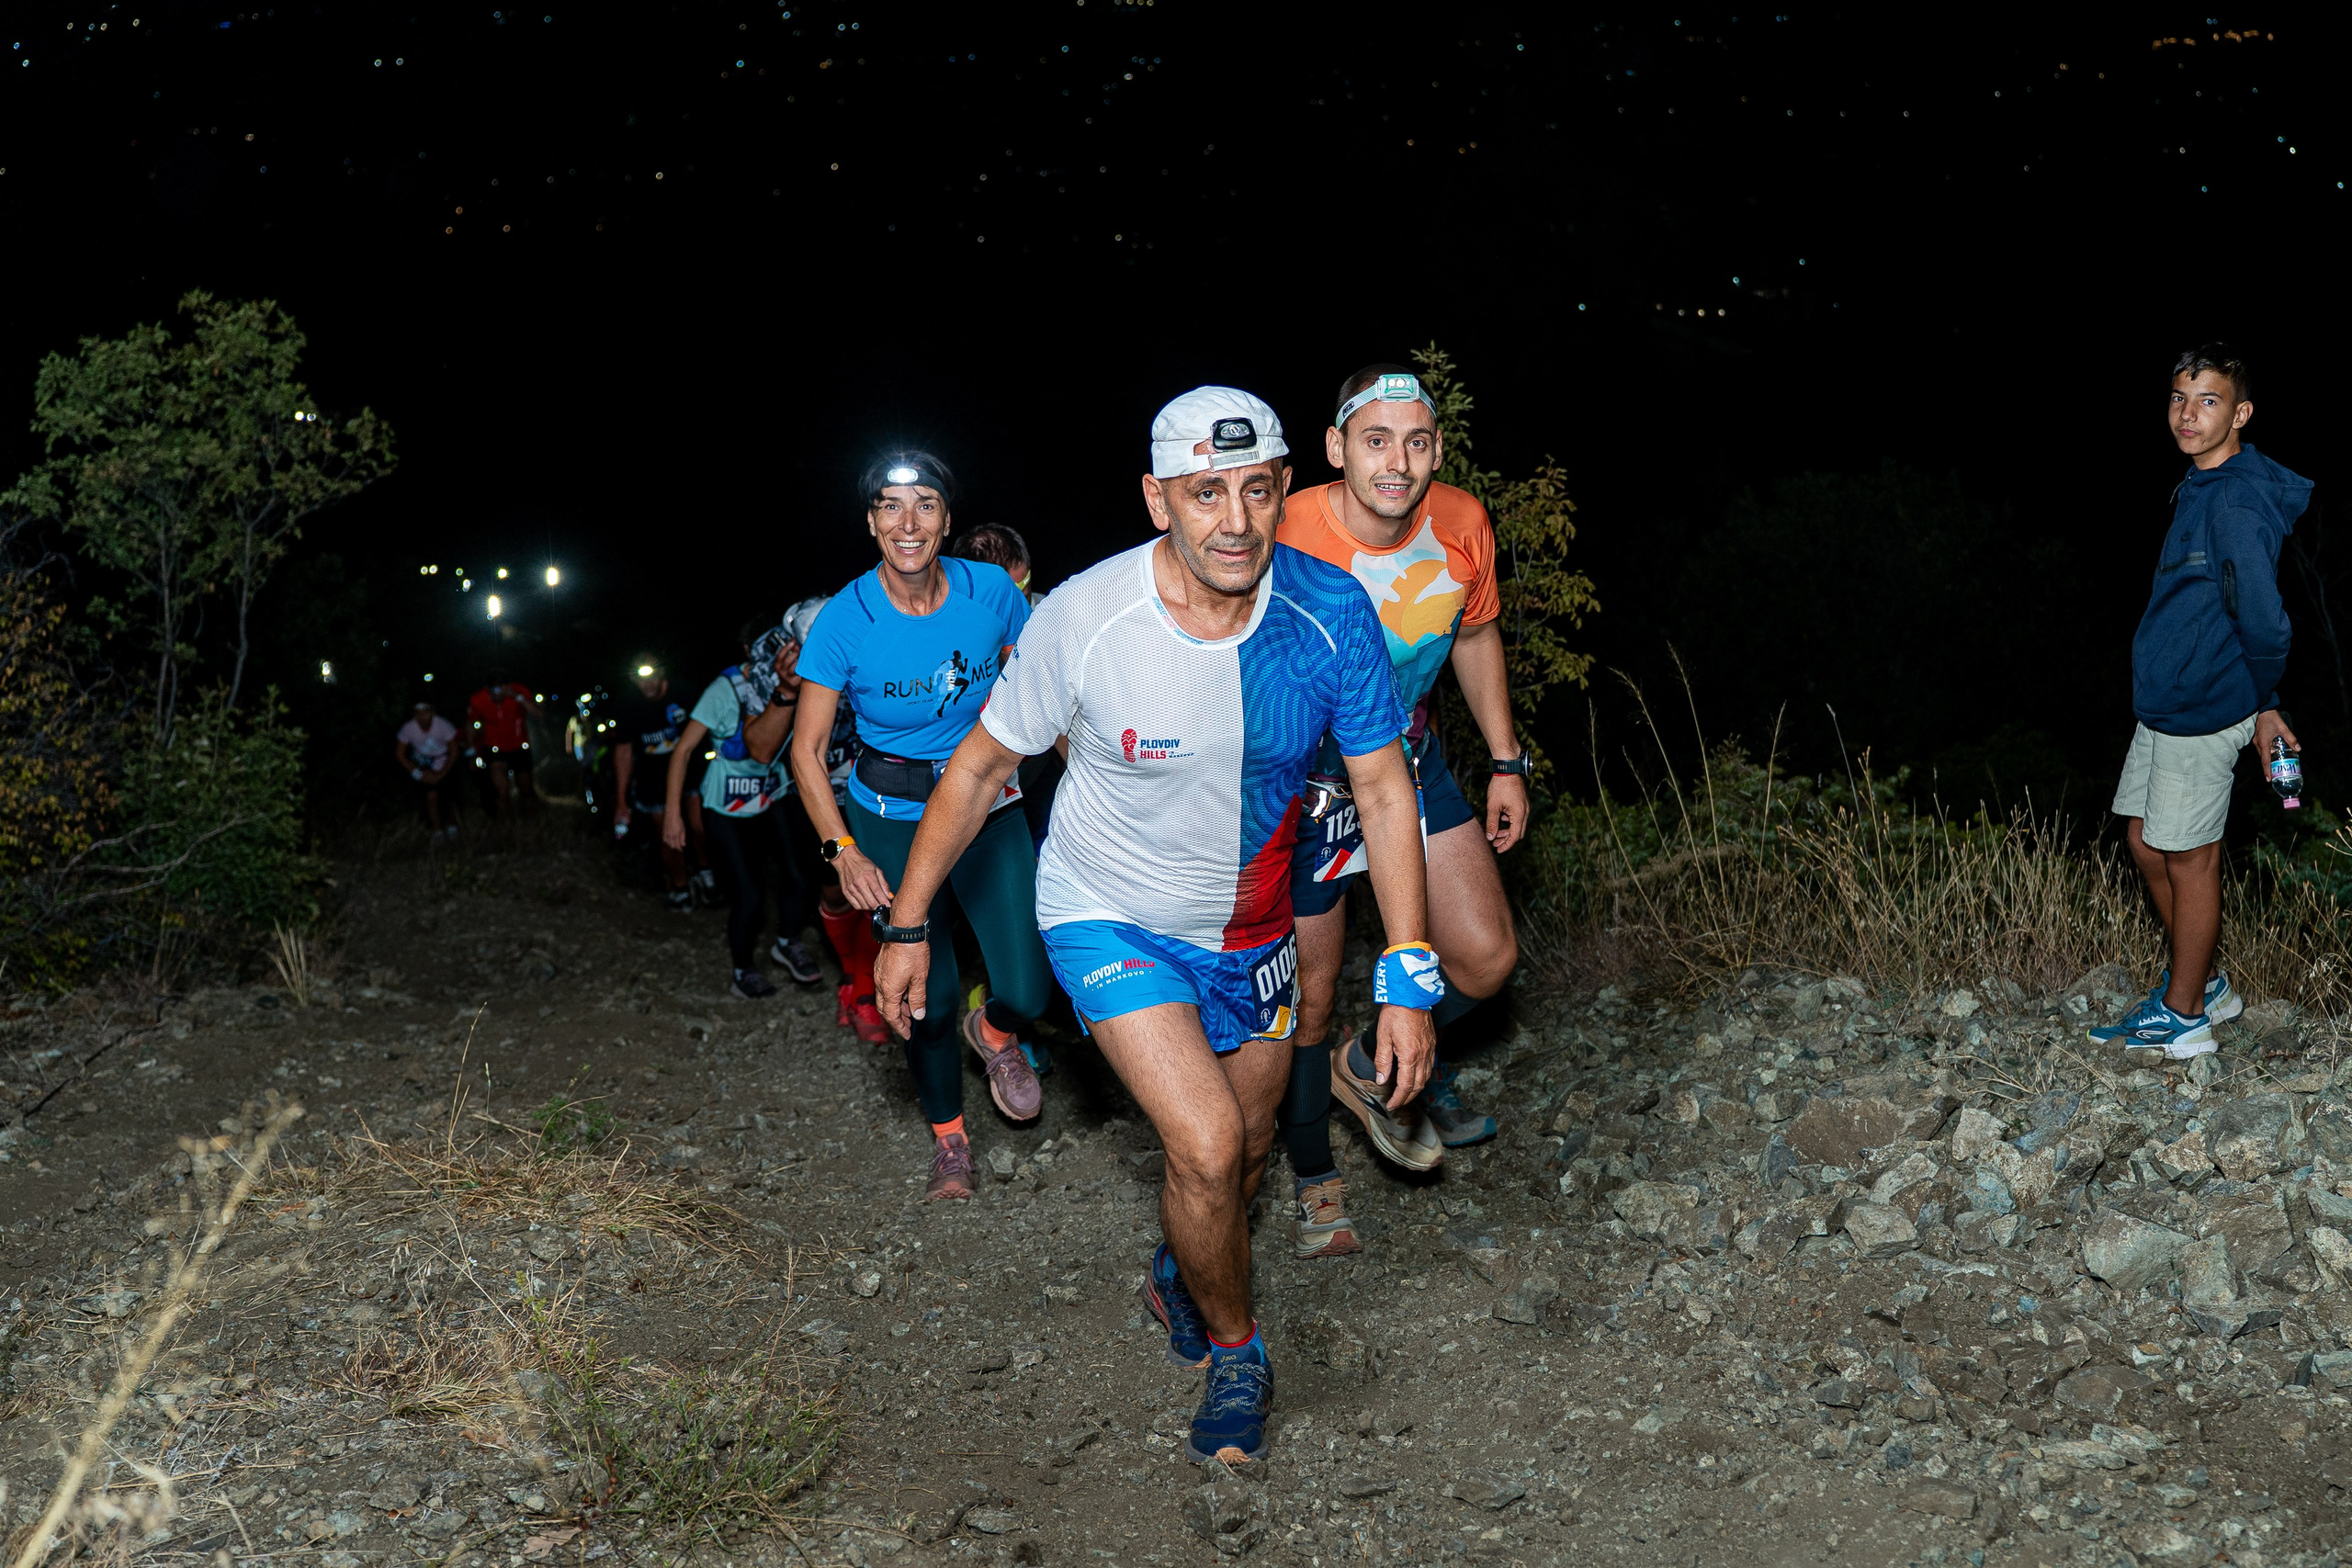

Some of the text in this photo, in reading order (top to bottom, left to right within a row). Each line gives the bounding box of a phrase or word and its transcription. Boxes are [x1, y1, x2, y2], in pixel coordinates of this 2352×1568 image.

[884, 657, 992, 698] RUN with ME
[1140, 739, 1180, 749] PLOVDIV
[1140, 750, 1167, 759] HILLS
[728, 778, 761, 795] 1106
[1326, 805, 1363, 843] 112
[1082, 960, 1122, 988] PLOVDIV
[1105, 970, 1145, 985] MARKOVO
[1256, 933, 1297, 1002] 0106
[1375, 960, 1388, 1003] EVERY
